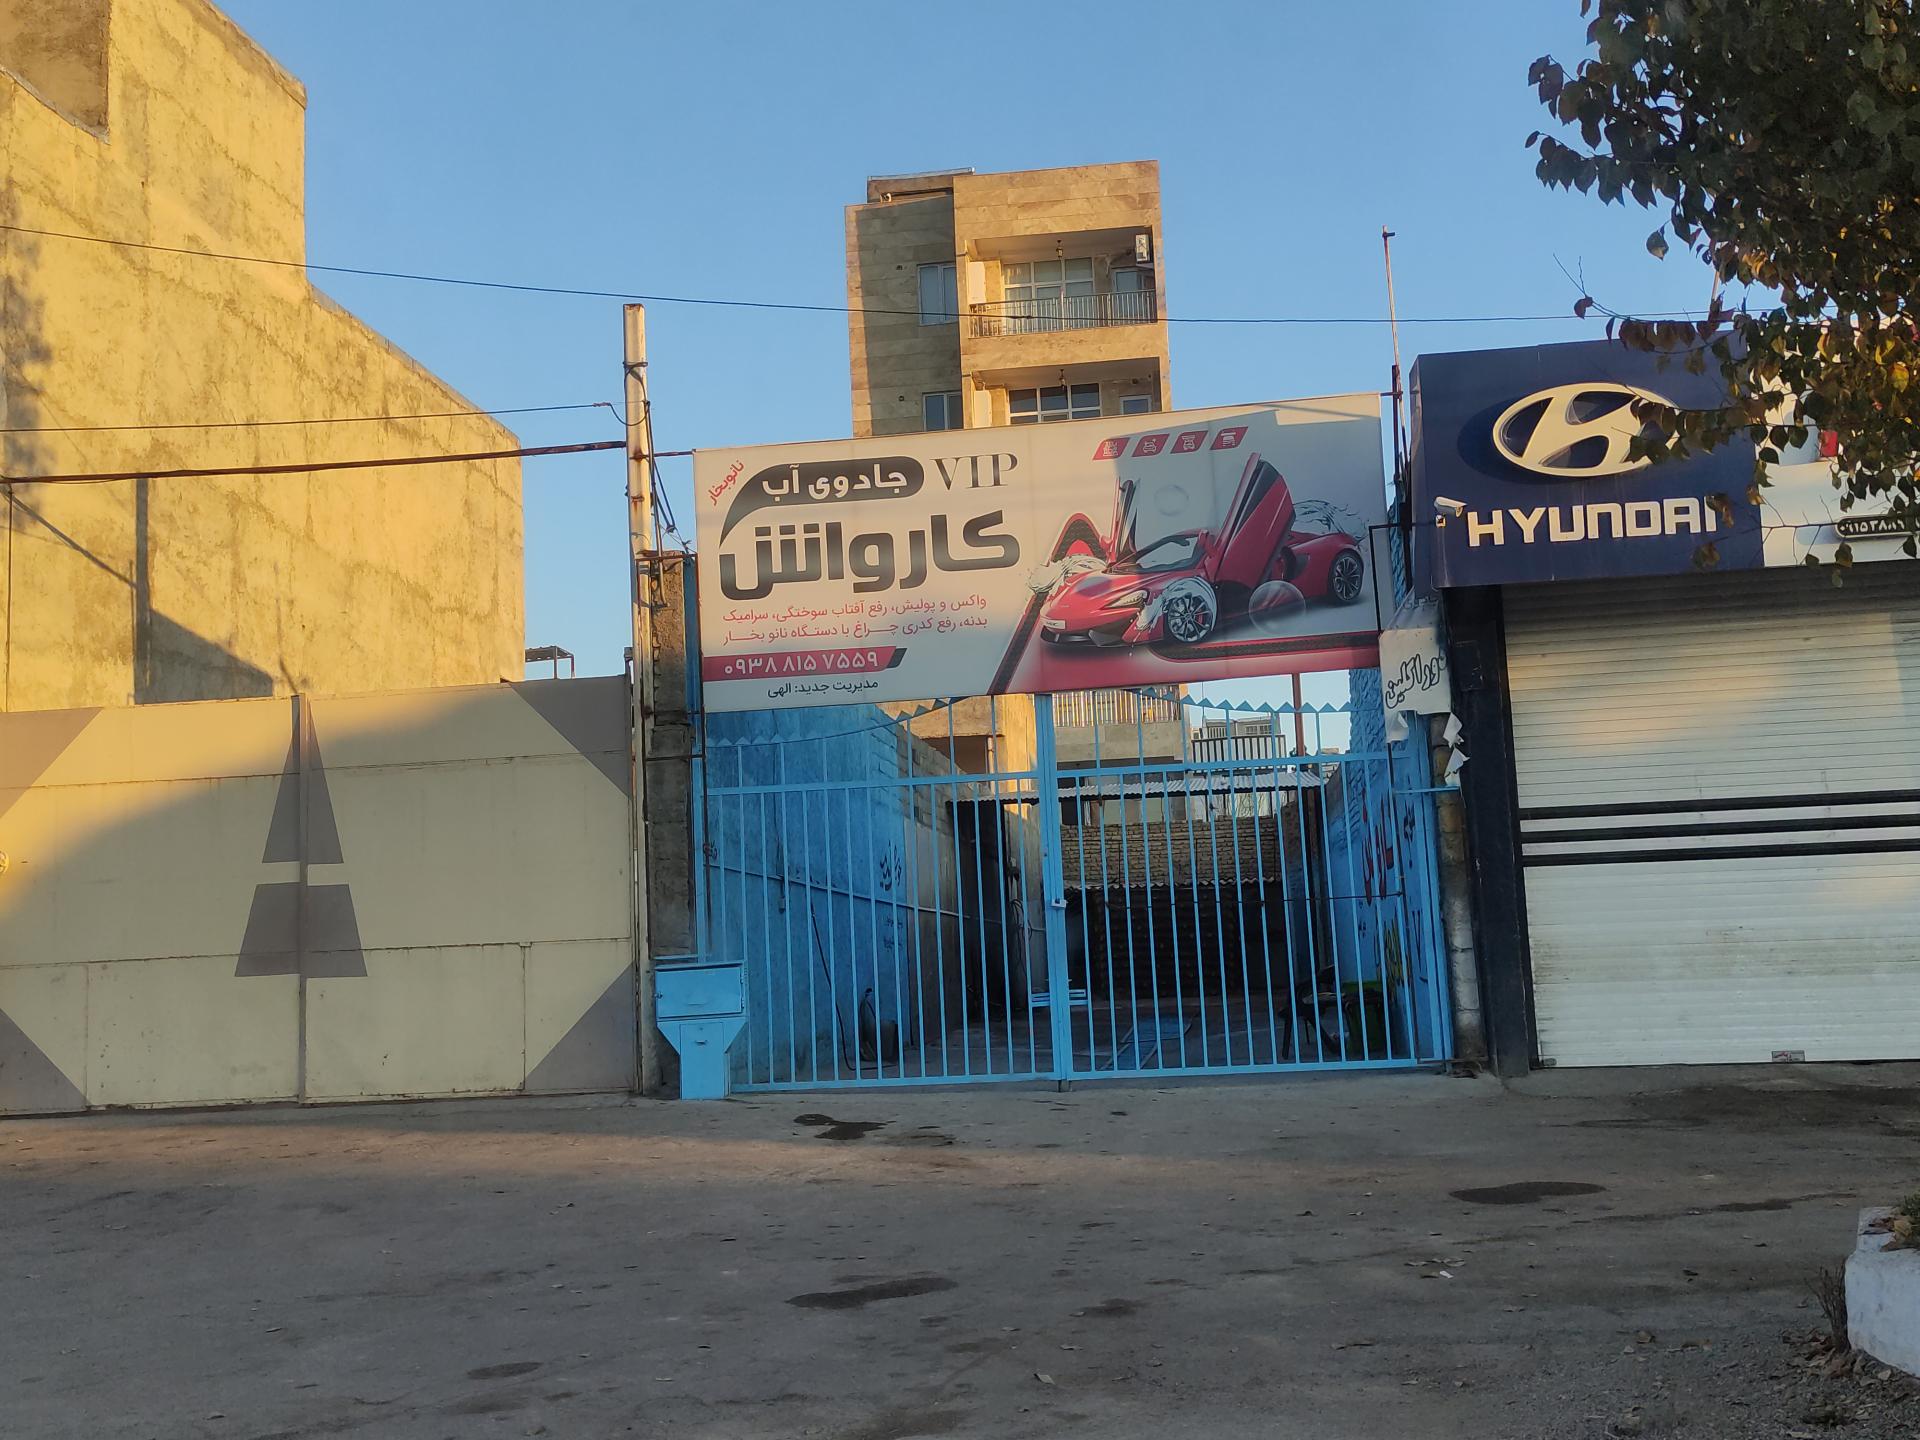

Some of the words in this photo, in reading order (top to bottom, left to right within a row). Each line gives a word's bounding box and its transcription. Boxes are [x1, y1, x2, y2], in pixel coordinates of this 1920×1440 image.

[929, 452, 1018, 491] VIP
[762, 463, 800, 502] آب
[808, 463, 908, 500] جادوی
[1467, 496, 1717, 547] HYUNDAI
[719, 509, 1021, 601] کارواش
[832, 600, 864, 618] آفتاب
[868, 600, 887, 617] رفع
[940, 601, 947, 612] و
[951, 594, 987, 611] واکس
[722, 608, 769, 624] سرامیک
[937, 616, 957, 633] رفع
[791, 623, 838, 638] دستگاه
[841, 623, 850, 636] با
[902, 617, 933, 635] کدری
[722, 629, 765, 646] بخار
[768, 627, 788, 643] نانو
[724, 656, 778, 675] ۰۹۳۸
[782, 654, 817, 672] ۸۱۵
[821, 651, 878, 670] ۷۵۵۹
[767, 682, 792, 698] الهی
[832, 680, 879, 695] مدیریت
